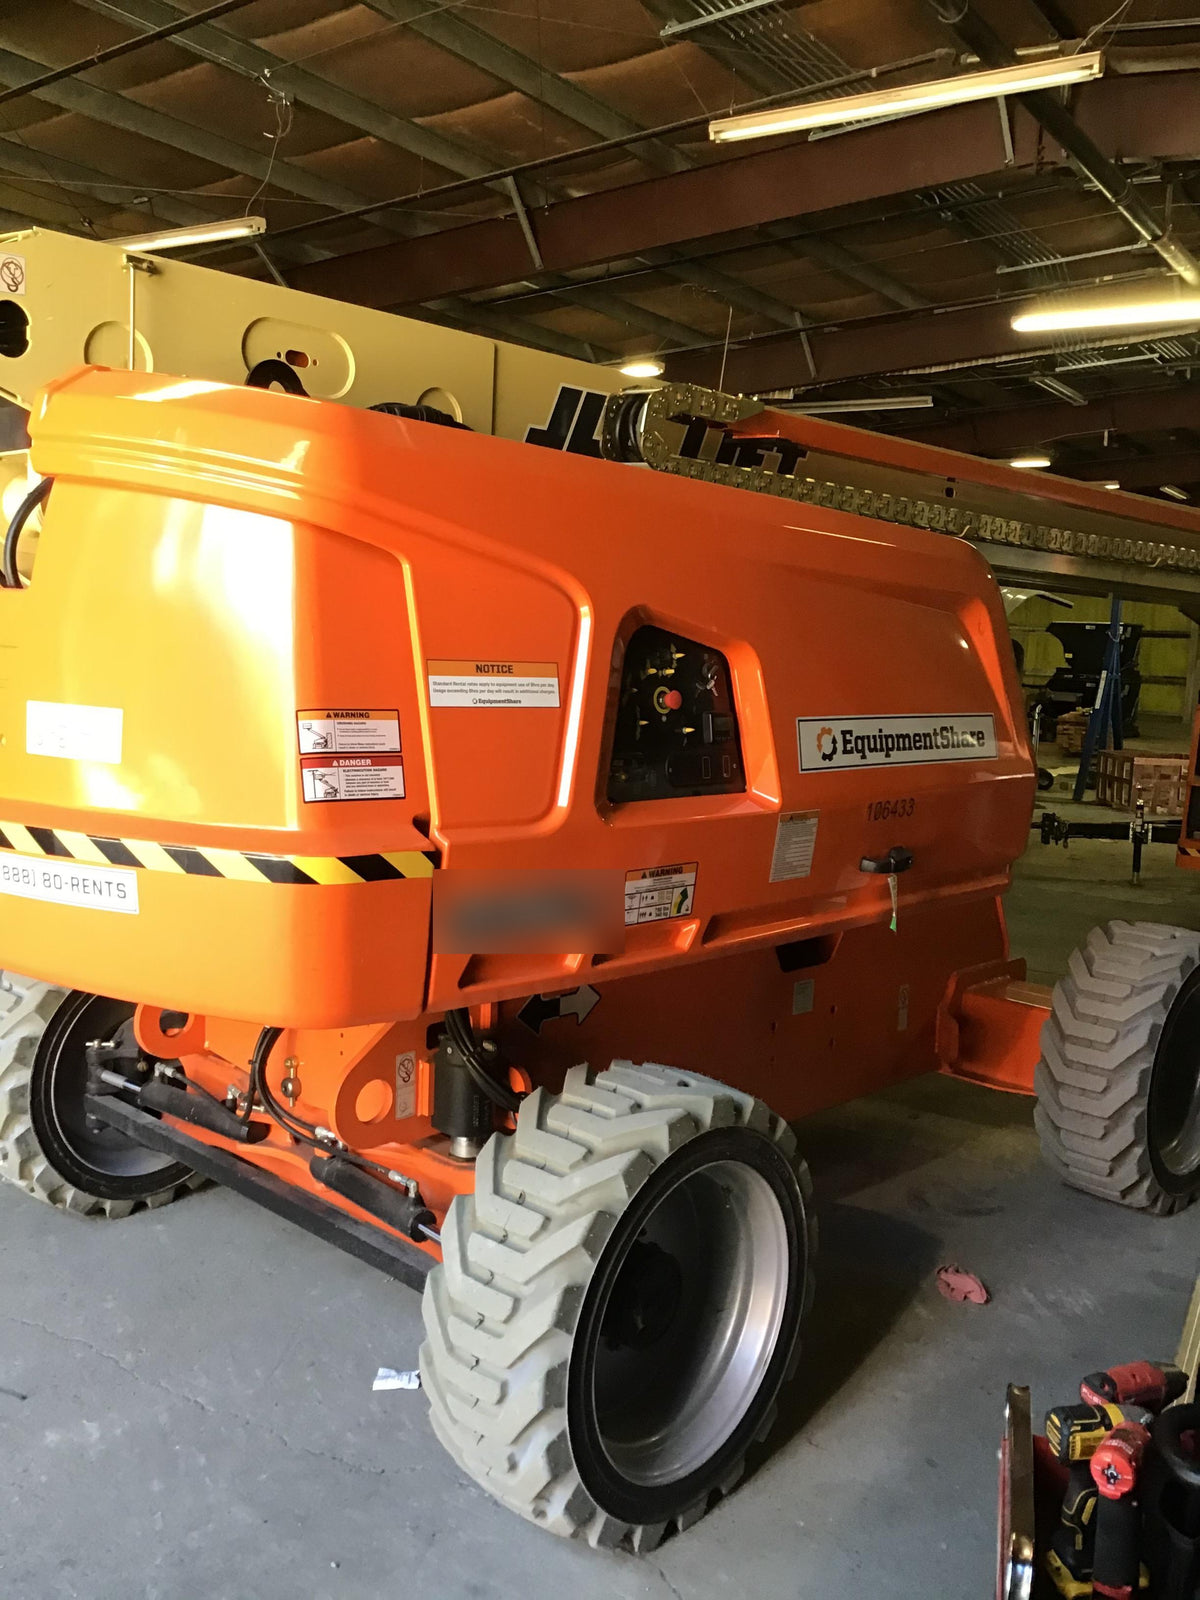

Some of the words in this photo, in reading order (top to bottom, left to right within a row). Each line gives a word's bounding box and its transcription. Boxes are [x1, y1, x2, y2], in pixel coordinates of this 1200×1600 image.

[525, 386, 605, 459] JL
[475, 664, 514, 674] NOTICE
[841, 724, 985, 759] EquipmentShare
[339, 758, 372, 766] DANGER
[866, 798, 916, 822] 106433
[648, 866, 683, 878] WARNING
[42, 872, 127, 899] 80-RENTS
